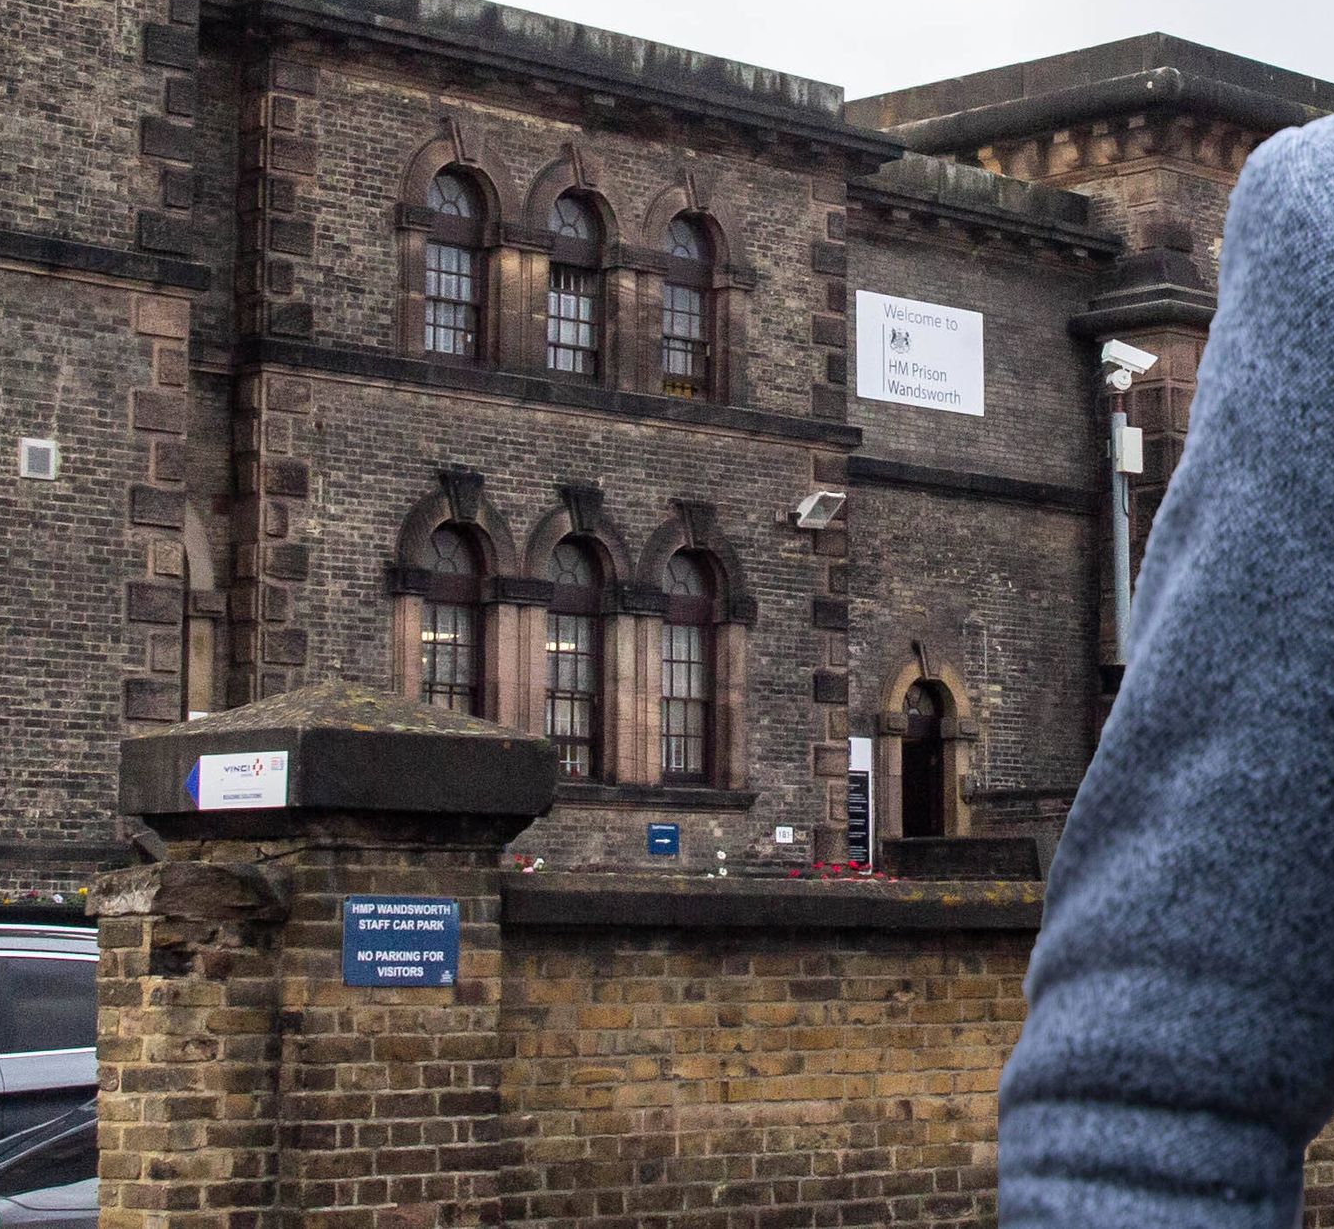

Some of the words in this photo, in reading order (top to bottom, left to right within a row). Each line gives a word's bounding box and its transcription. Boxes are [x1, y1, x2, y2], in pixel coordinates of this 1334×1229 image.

[884, 303, 941, 327] Welcome
[946, 318, 958, 331] to
[889, 360, 908, 376] HM
[912, 363, 947, 382] Prison
[888, 380, 961, 405] Wandsworth
[352, 903, 375, 914] HMP
[377, 904, 451, 915] WANDSWORTH
[358, 919, 390, 930] STAFF
[393, 920, 414, 931] CAR
[417, 920, 444, 931] PARK
[357, 951, 372, 962] NO
[375, 951, 420, 962] PARKING
[423, 951, 444, 961] FOR
[377, 967, 424, 977] VISITORS
